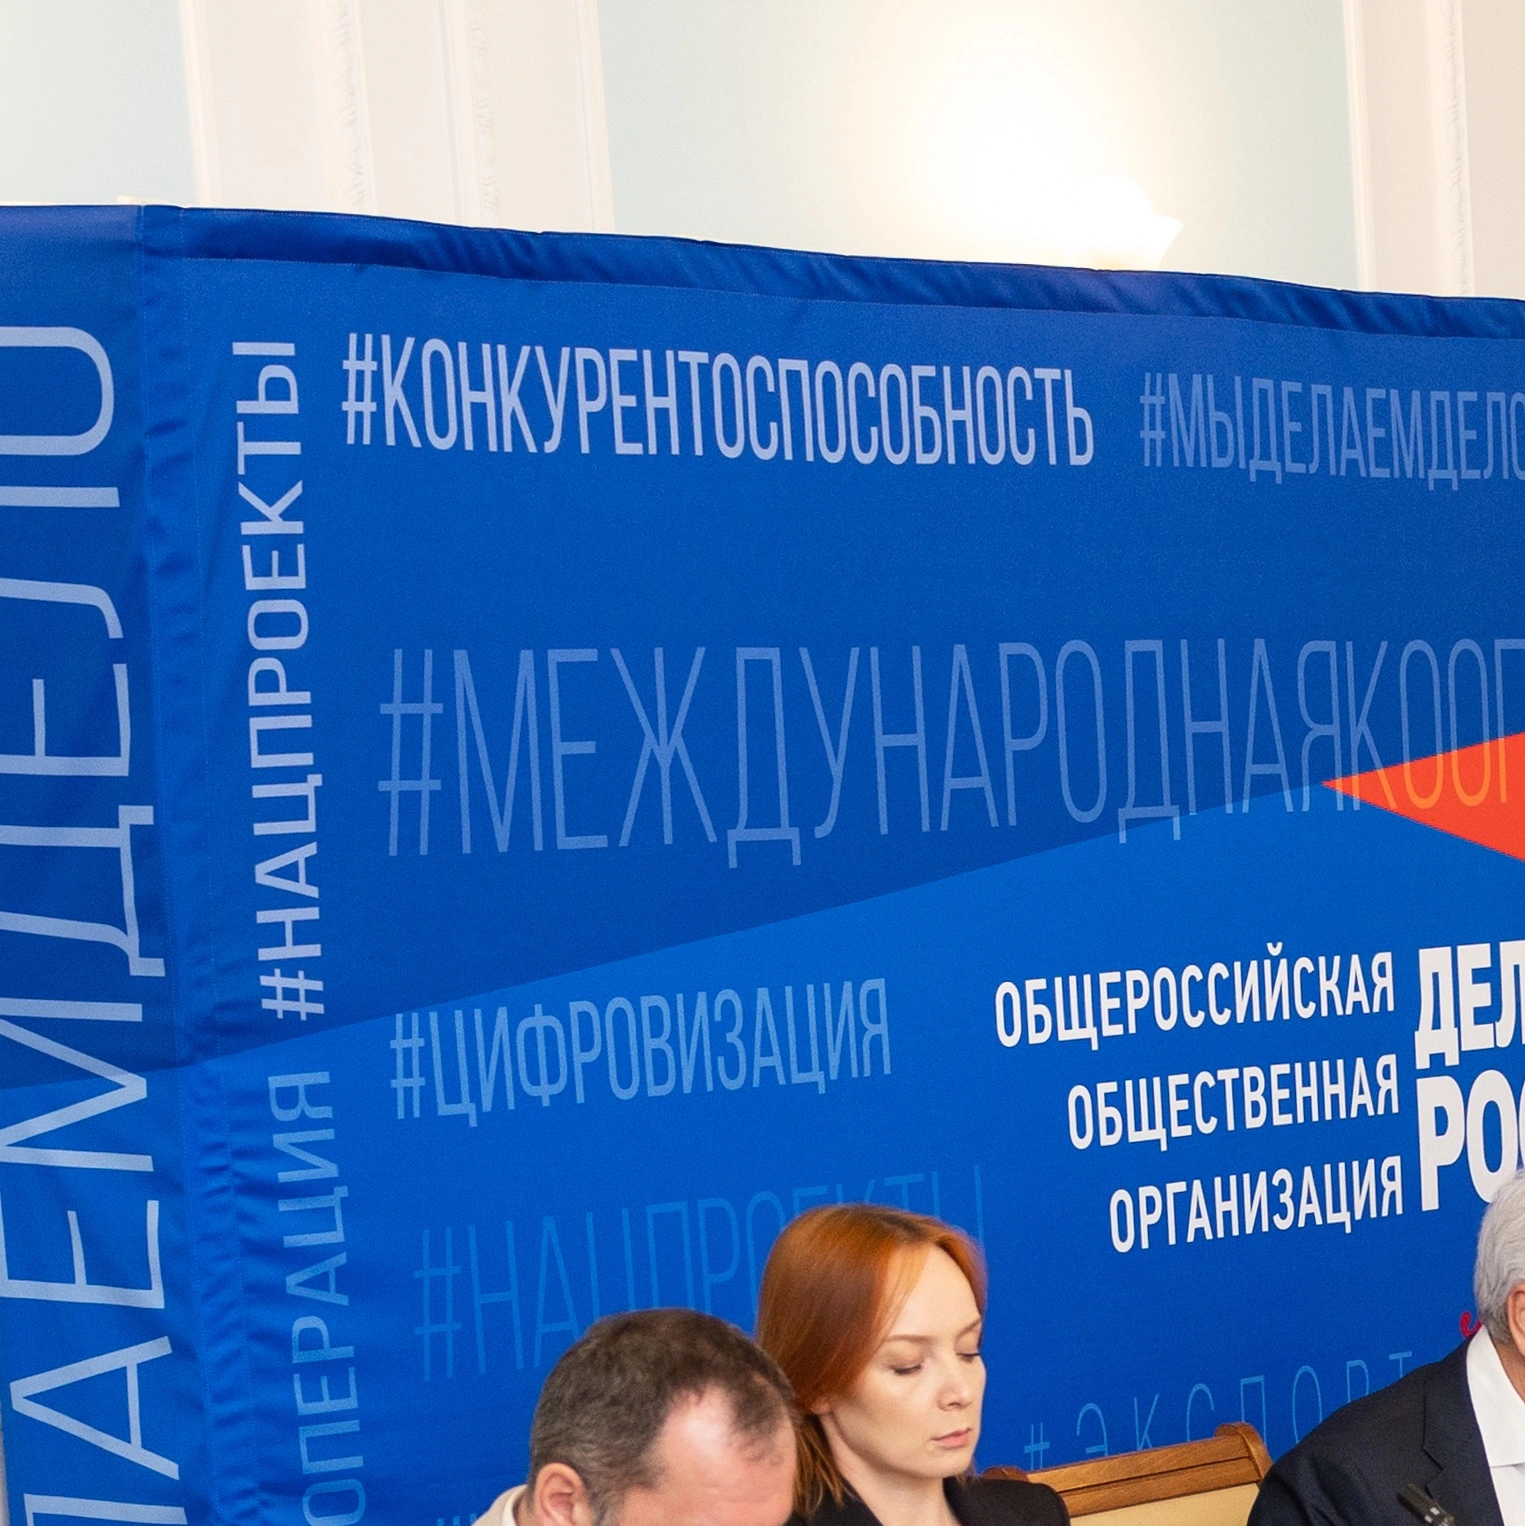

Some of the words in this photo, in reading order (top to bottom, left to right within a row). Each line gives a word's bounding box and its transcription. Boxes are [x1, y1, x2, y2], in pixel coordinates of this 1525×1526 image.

[342, 332, 1095, 467] #КОНКУРЕНТОСПОСОБНОСТЬ
[233, 340, 325, 1021] #НАЦПРОЕКТЫ
[389, 977, 892, 1127] #ЦИФРОВИЗАЦИЯ
[994, 942, 1396, 1050] ОБЩЕРОССИЙСКАЯ
[1067, 1053, 1400, 1152] ОБЩЕСТВЕННАЯ
[1109, 1154, 1403, 1254] ОРГАНИЗАЦИЯ
